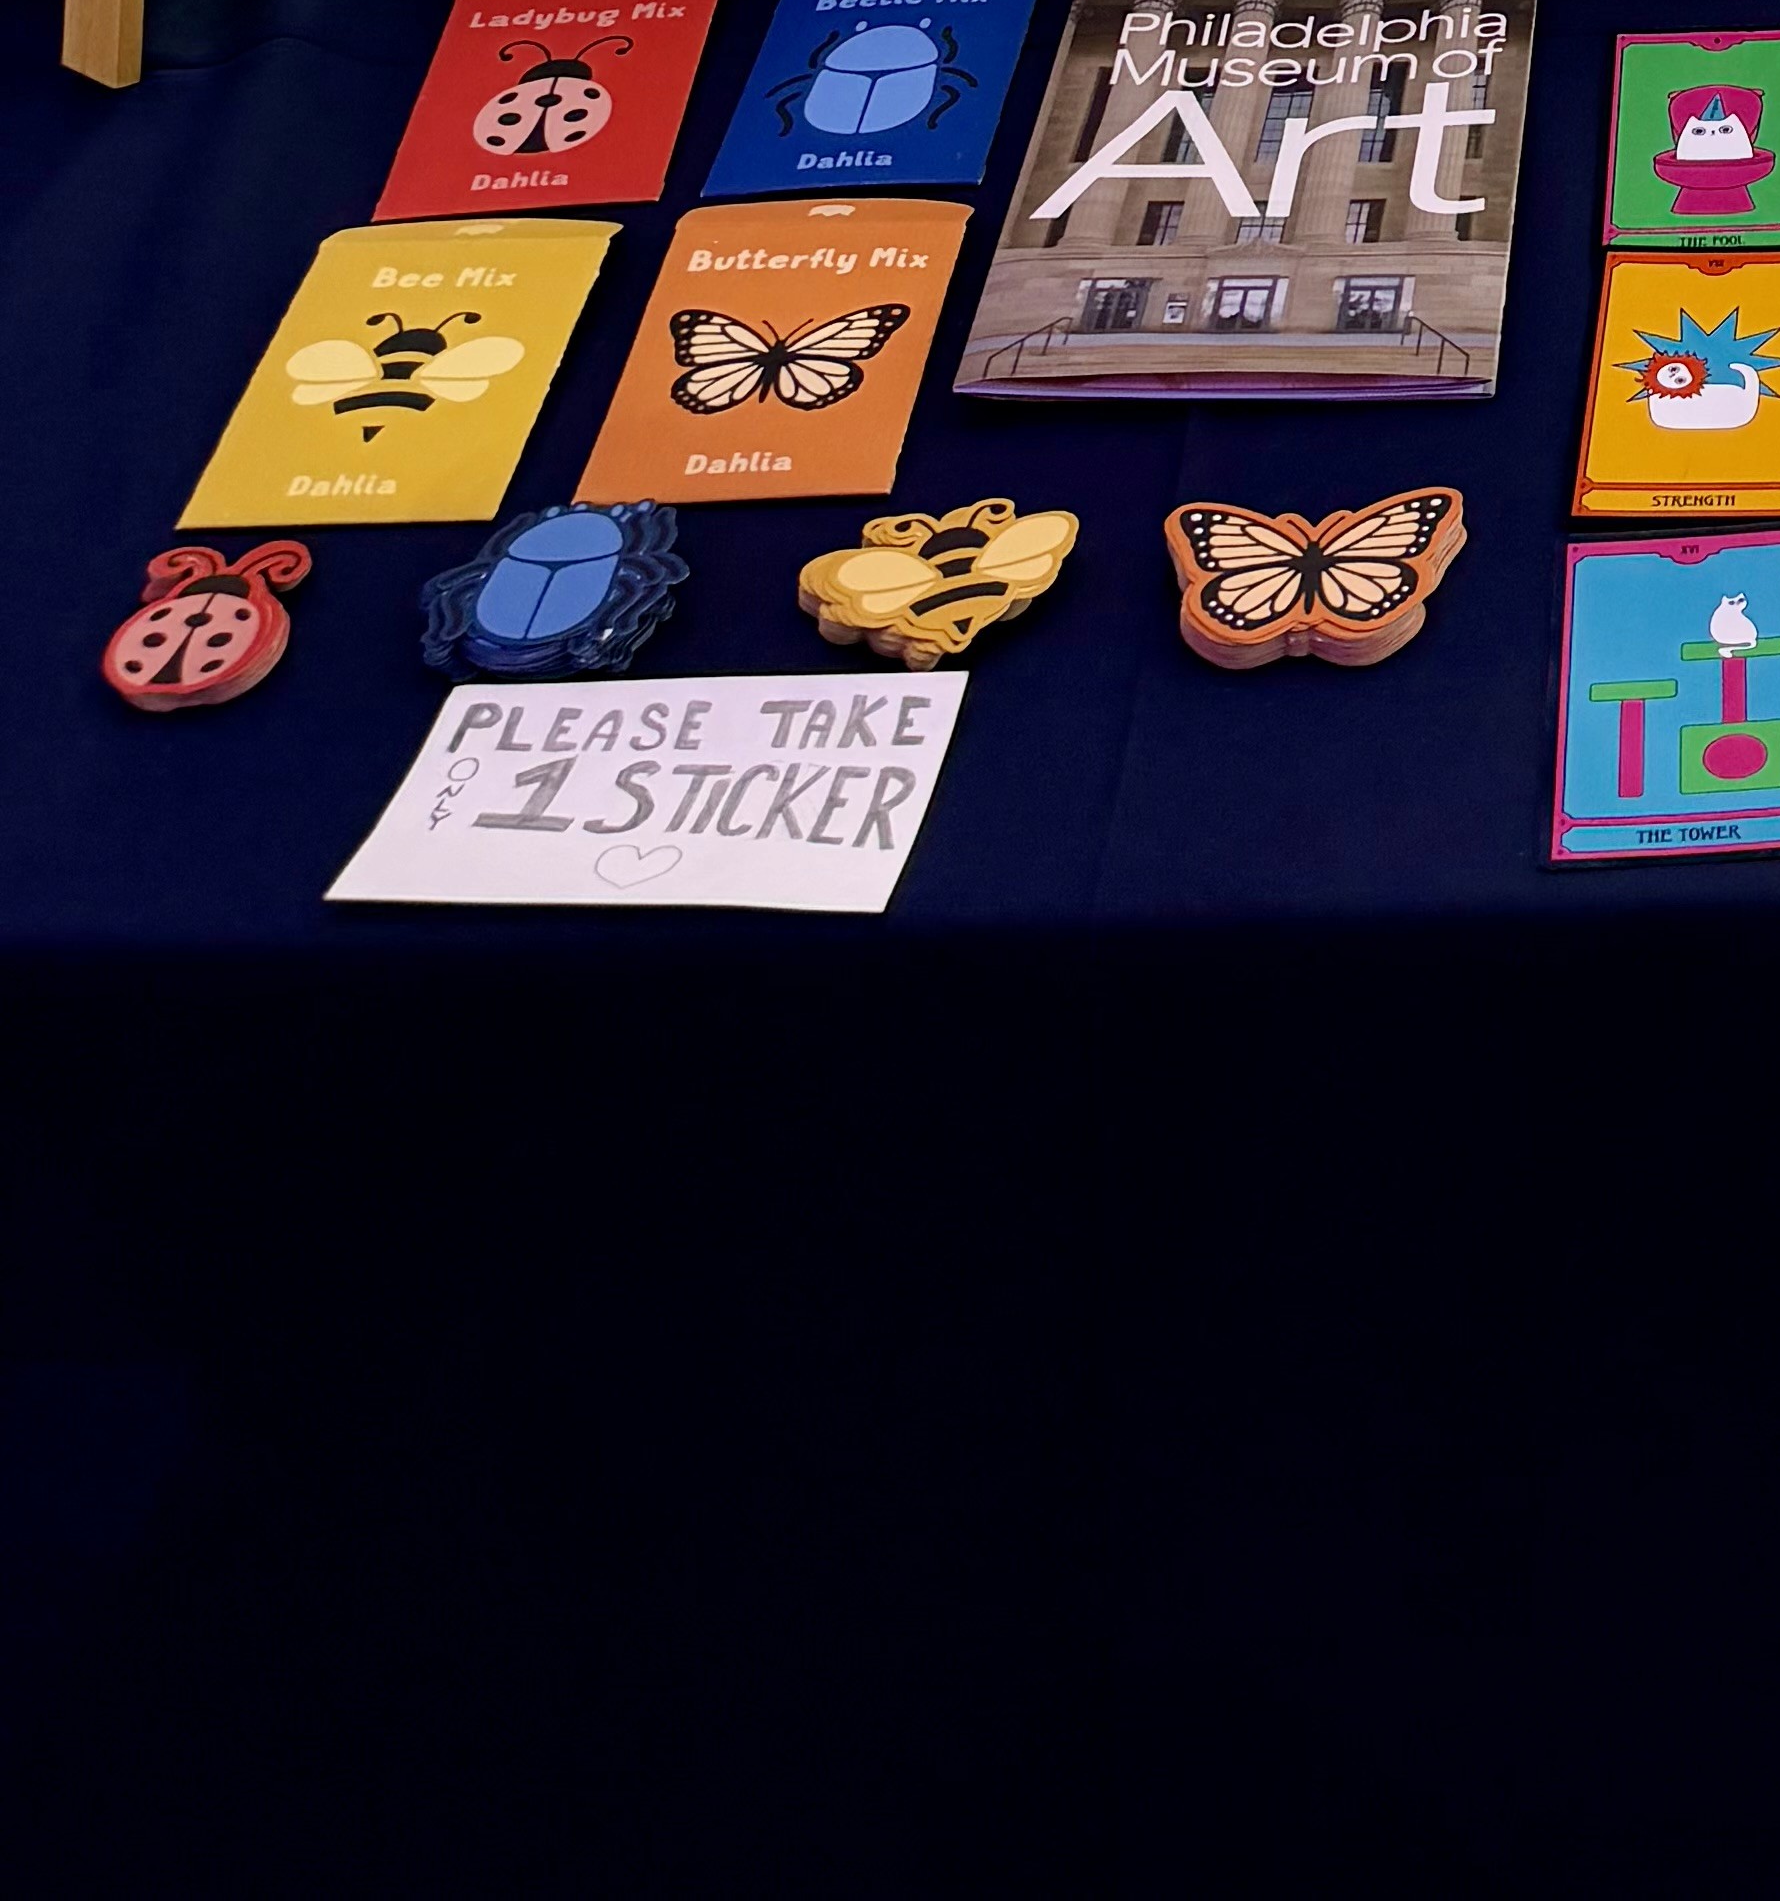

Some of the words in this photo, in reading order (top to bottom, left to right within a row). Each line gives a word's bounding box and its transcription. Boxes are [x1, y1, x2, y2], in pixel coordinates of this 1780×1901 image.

[469, 5, 620, 30] Ladybug
[631, 1, 686, 20] Mix
[1119, 8, 1508, 52] Philadelphia
[1109, 49, 1417, 88] Museum
[1431, 37, 1509, 76] of
[797, 150, 893, 170] Dahlia
[1029, 81, 1497, 220] Art
[470, 169, 569, 192] Dahlia
[686, 248, 857, 277] Butterfly
[870, 247, 929, 271] Mix
[371, 266, 443, 289] Bee
[455, 266, 518, 288] Mix
[685, 451, 793, 476] Dahlia
[287, 474, 397, 498] Dahlia
[1651, 493, 1737, 508] STRENGTH
[447, 700, 713, 754] PLEASE
[759, 694, 932, 749] TAKE
[428, 757, 480, 832] ONLY
[472, 755, 580, 833] 1
[583, 760, 917, 850] STICKER
[1636, 829, 1673, 845] THE
[1679, 825, 1741, 842] TOWER
